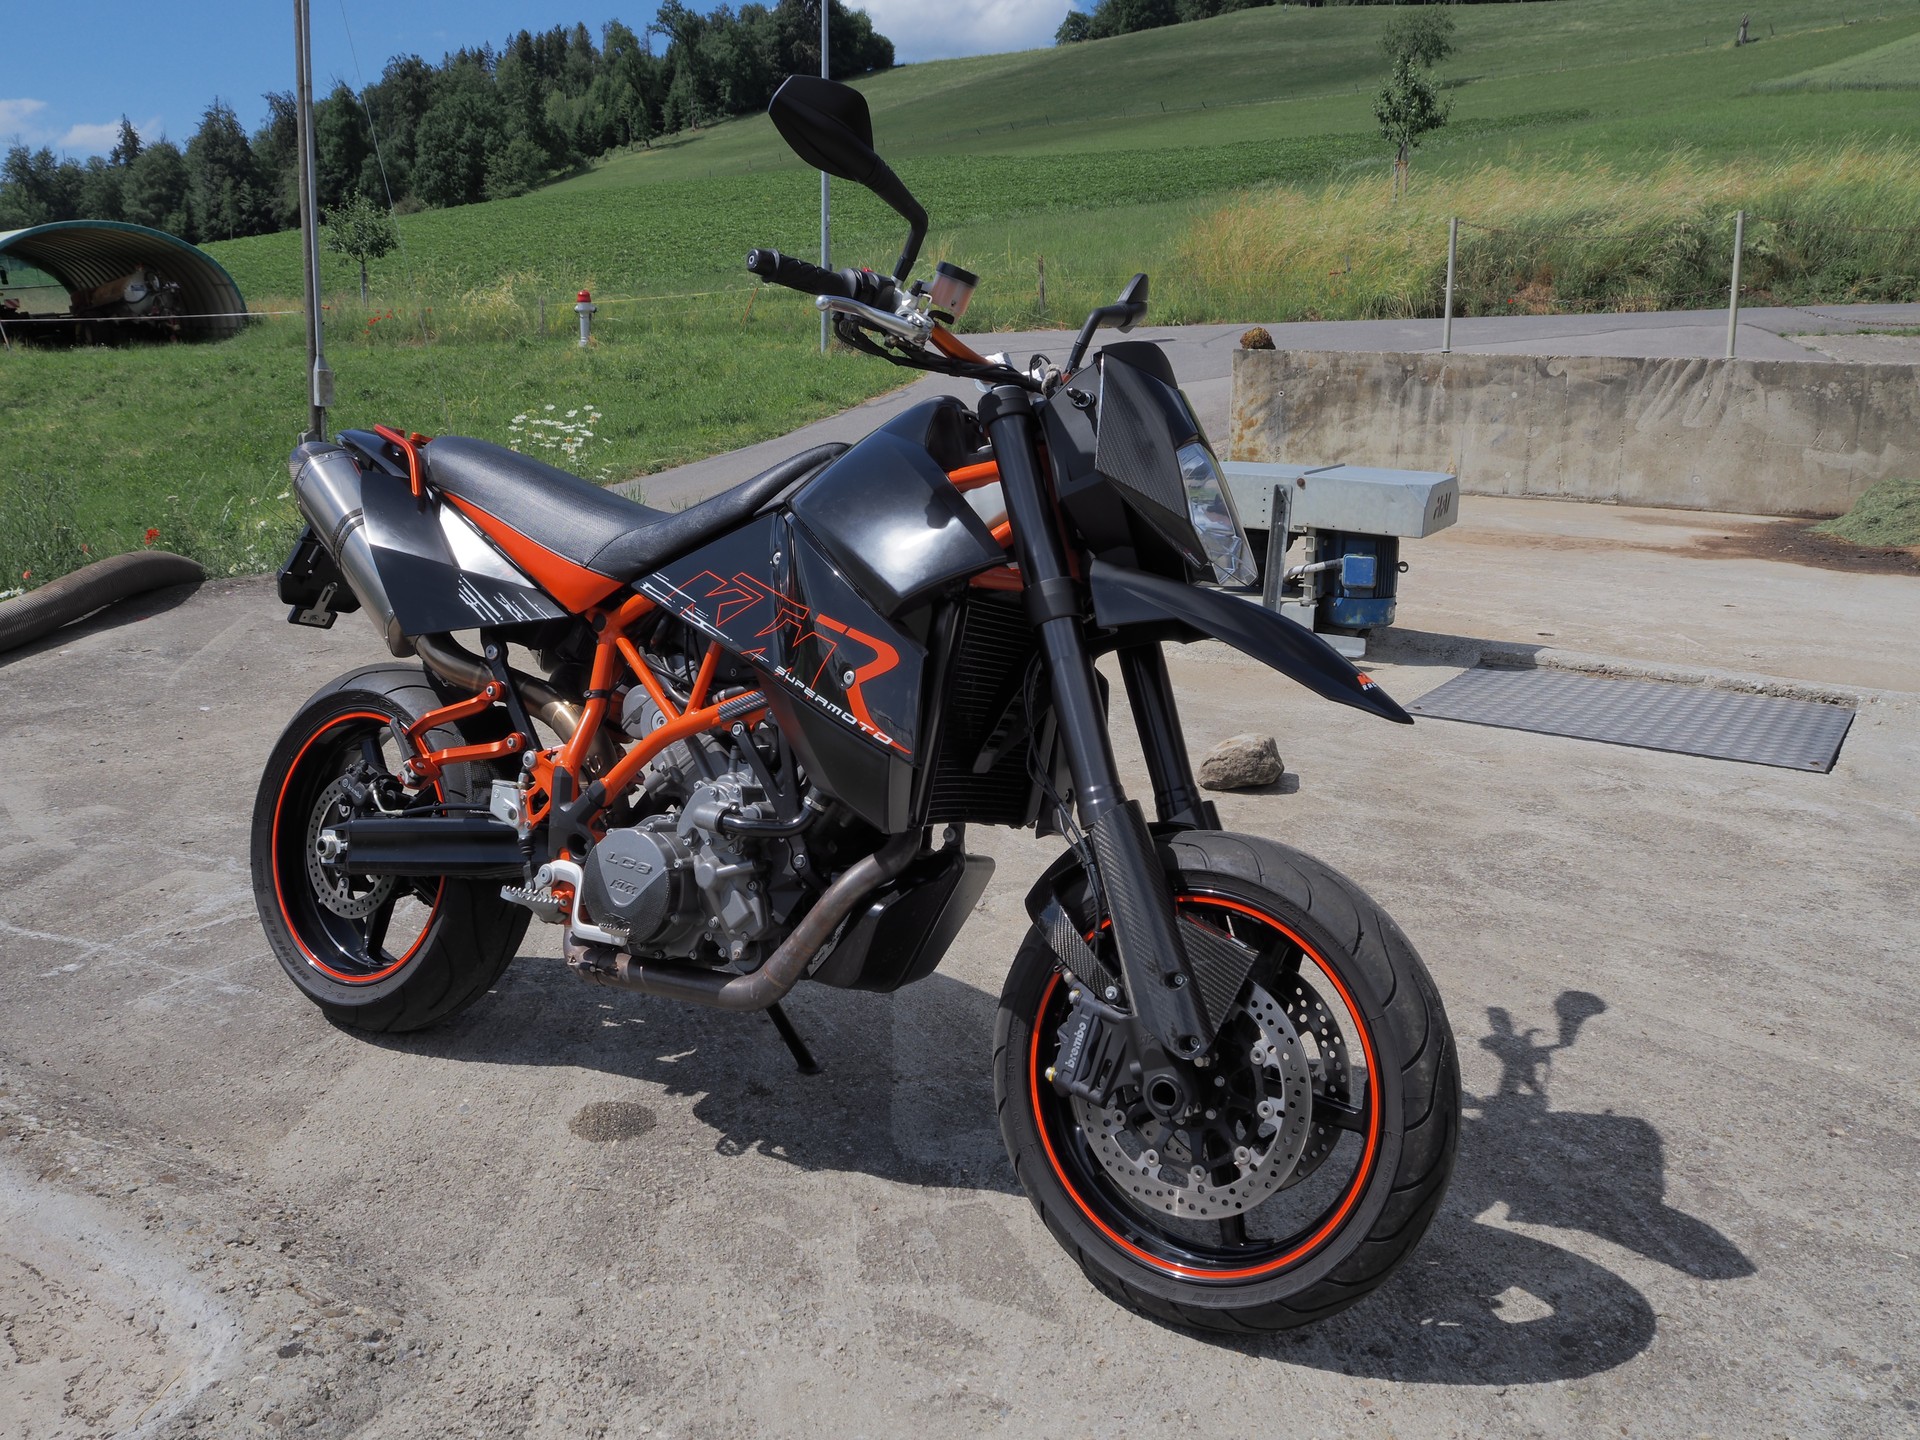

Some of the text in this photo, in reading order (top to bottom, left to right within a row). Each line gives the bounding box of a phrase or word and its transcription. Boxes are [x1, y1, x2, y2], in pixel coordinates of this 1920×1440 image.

[774, 665, 894, 746] SUPERMOTO
[605, 851, 653, 875] LC8
[262, 905, 311, 981] MICHELIN
[1064, 1021, 1087, 1069] brembo
